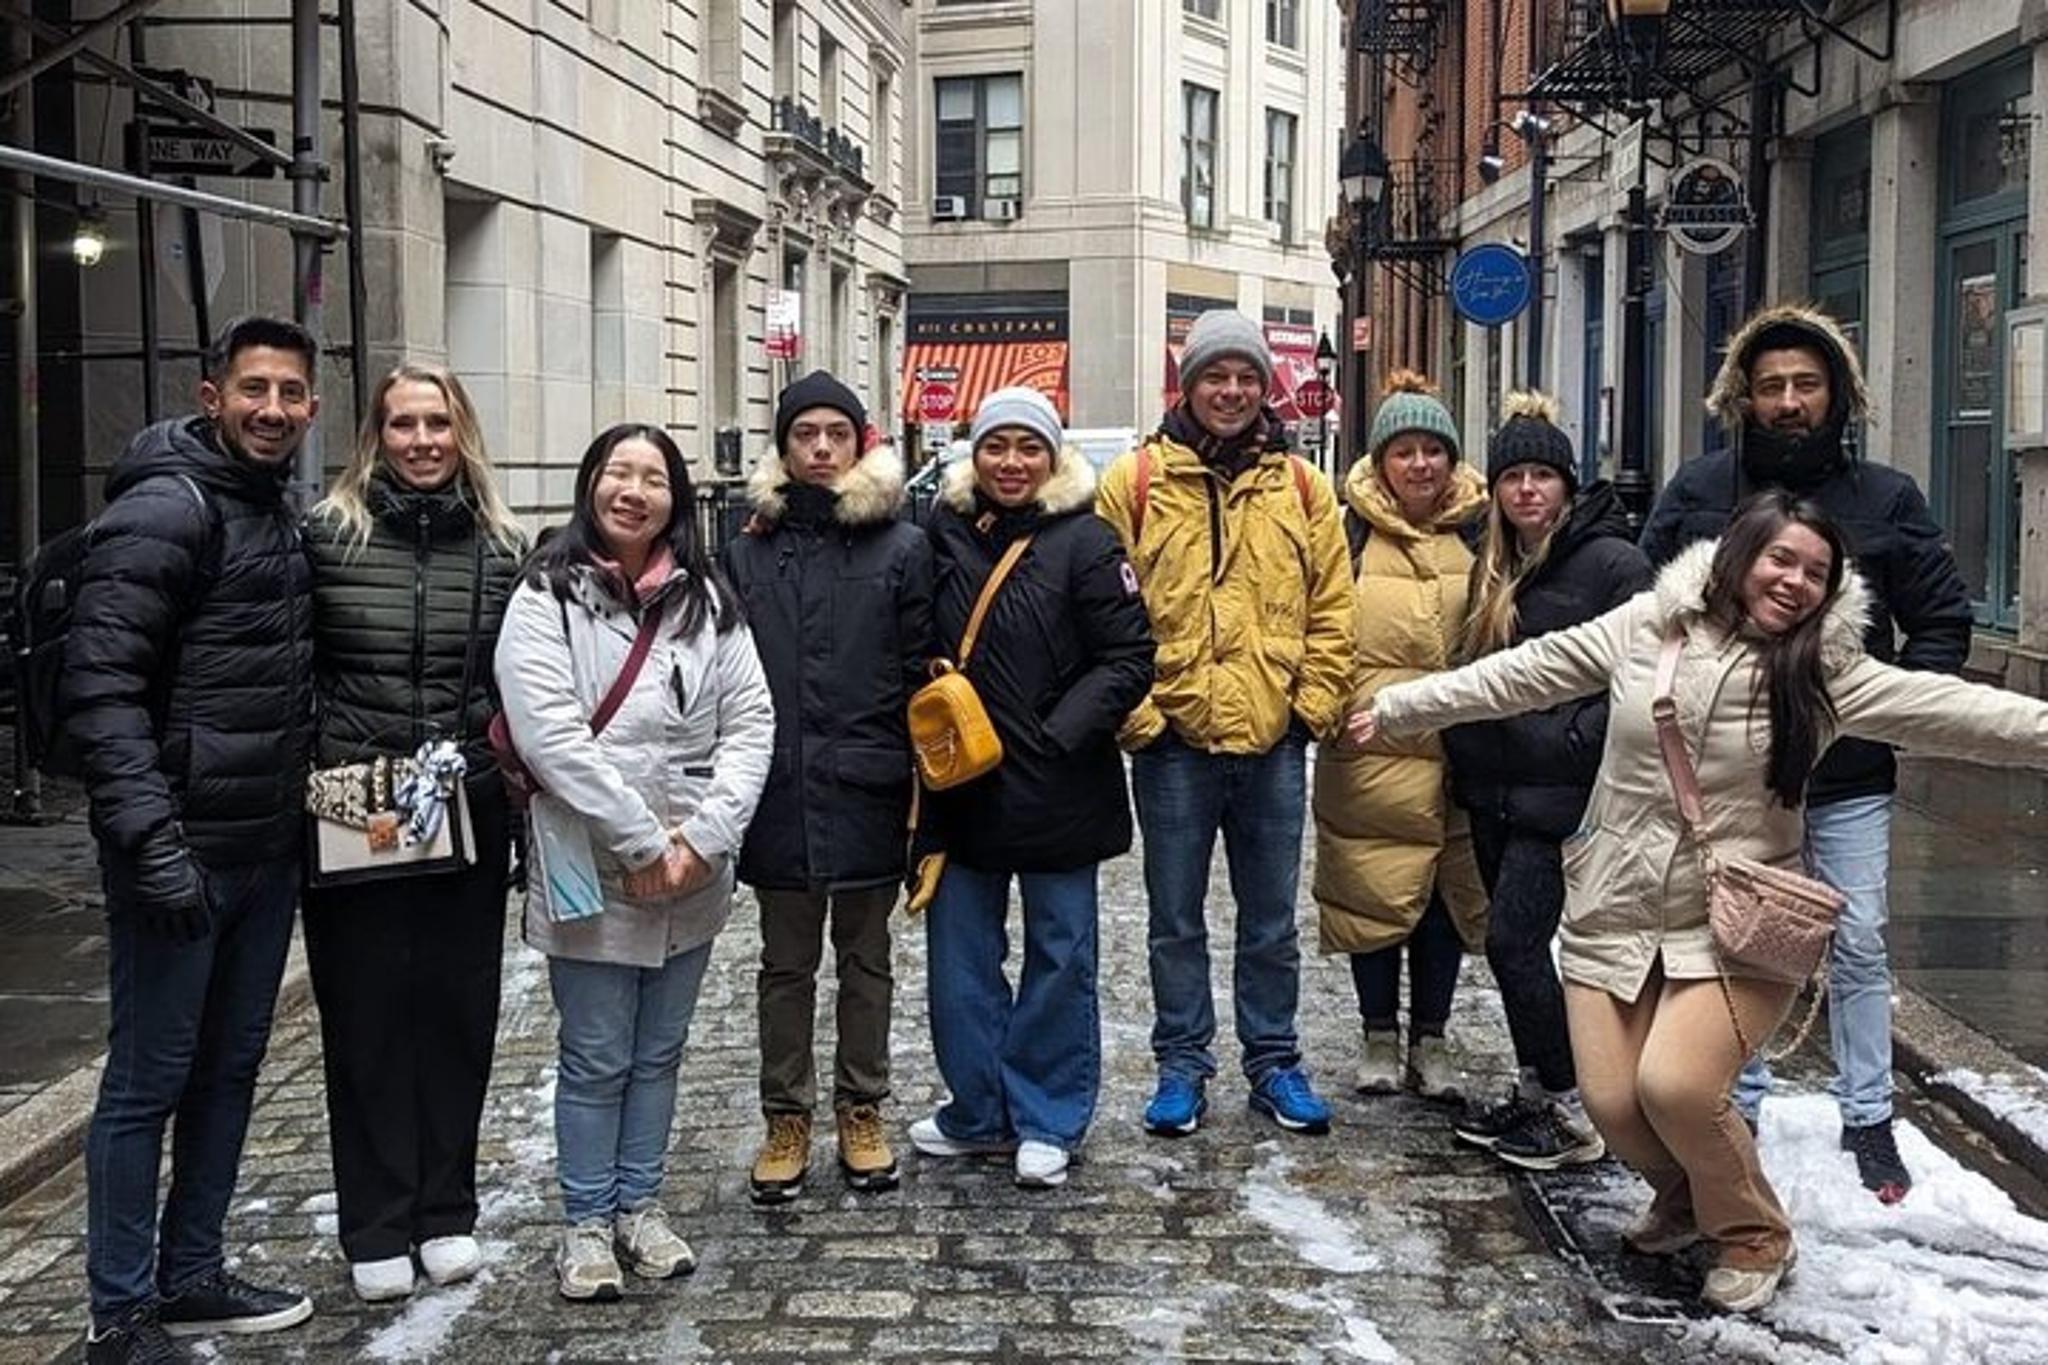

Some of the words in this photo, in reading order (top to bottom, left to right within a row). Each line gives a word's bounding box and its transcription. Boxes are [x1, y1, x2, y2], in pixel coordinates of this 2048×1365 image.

[190, 141, 235, 161] WAY
[920, 394, 953, 410] STOP
[1297, 391, 1333, 407] STOP
